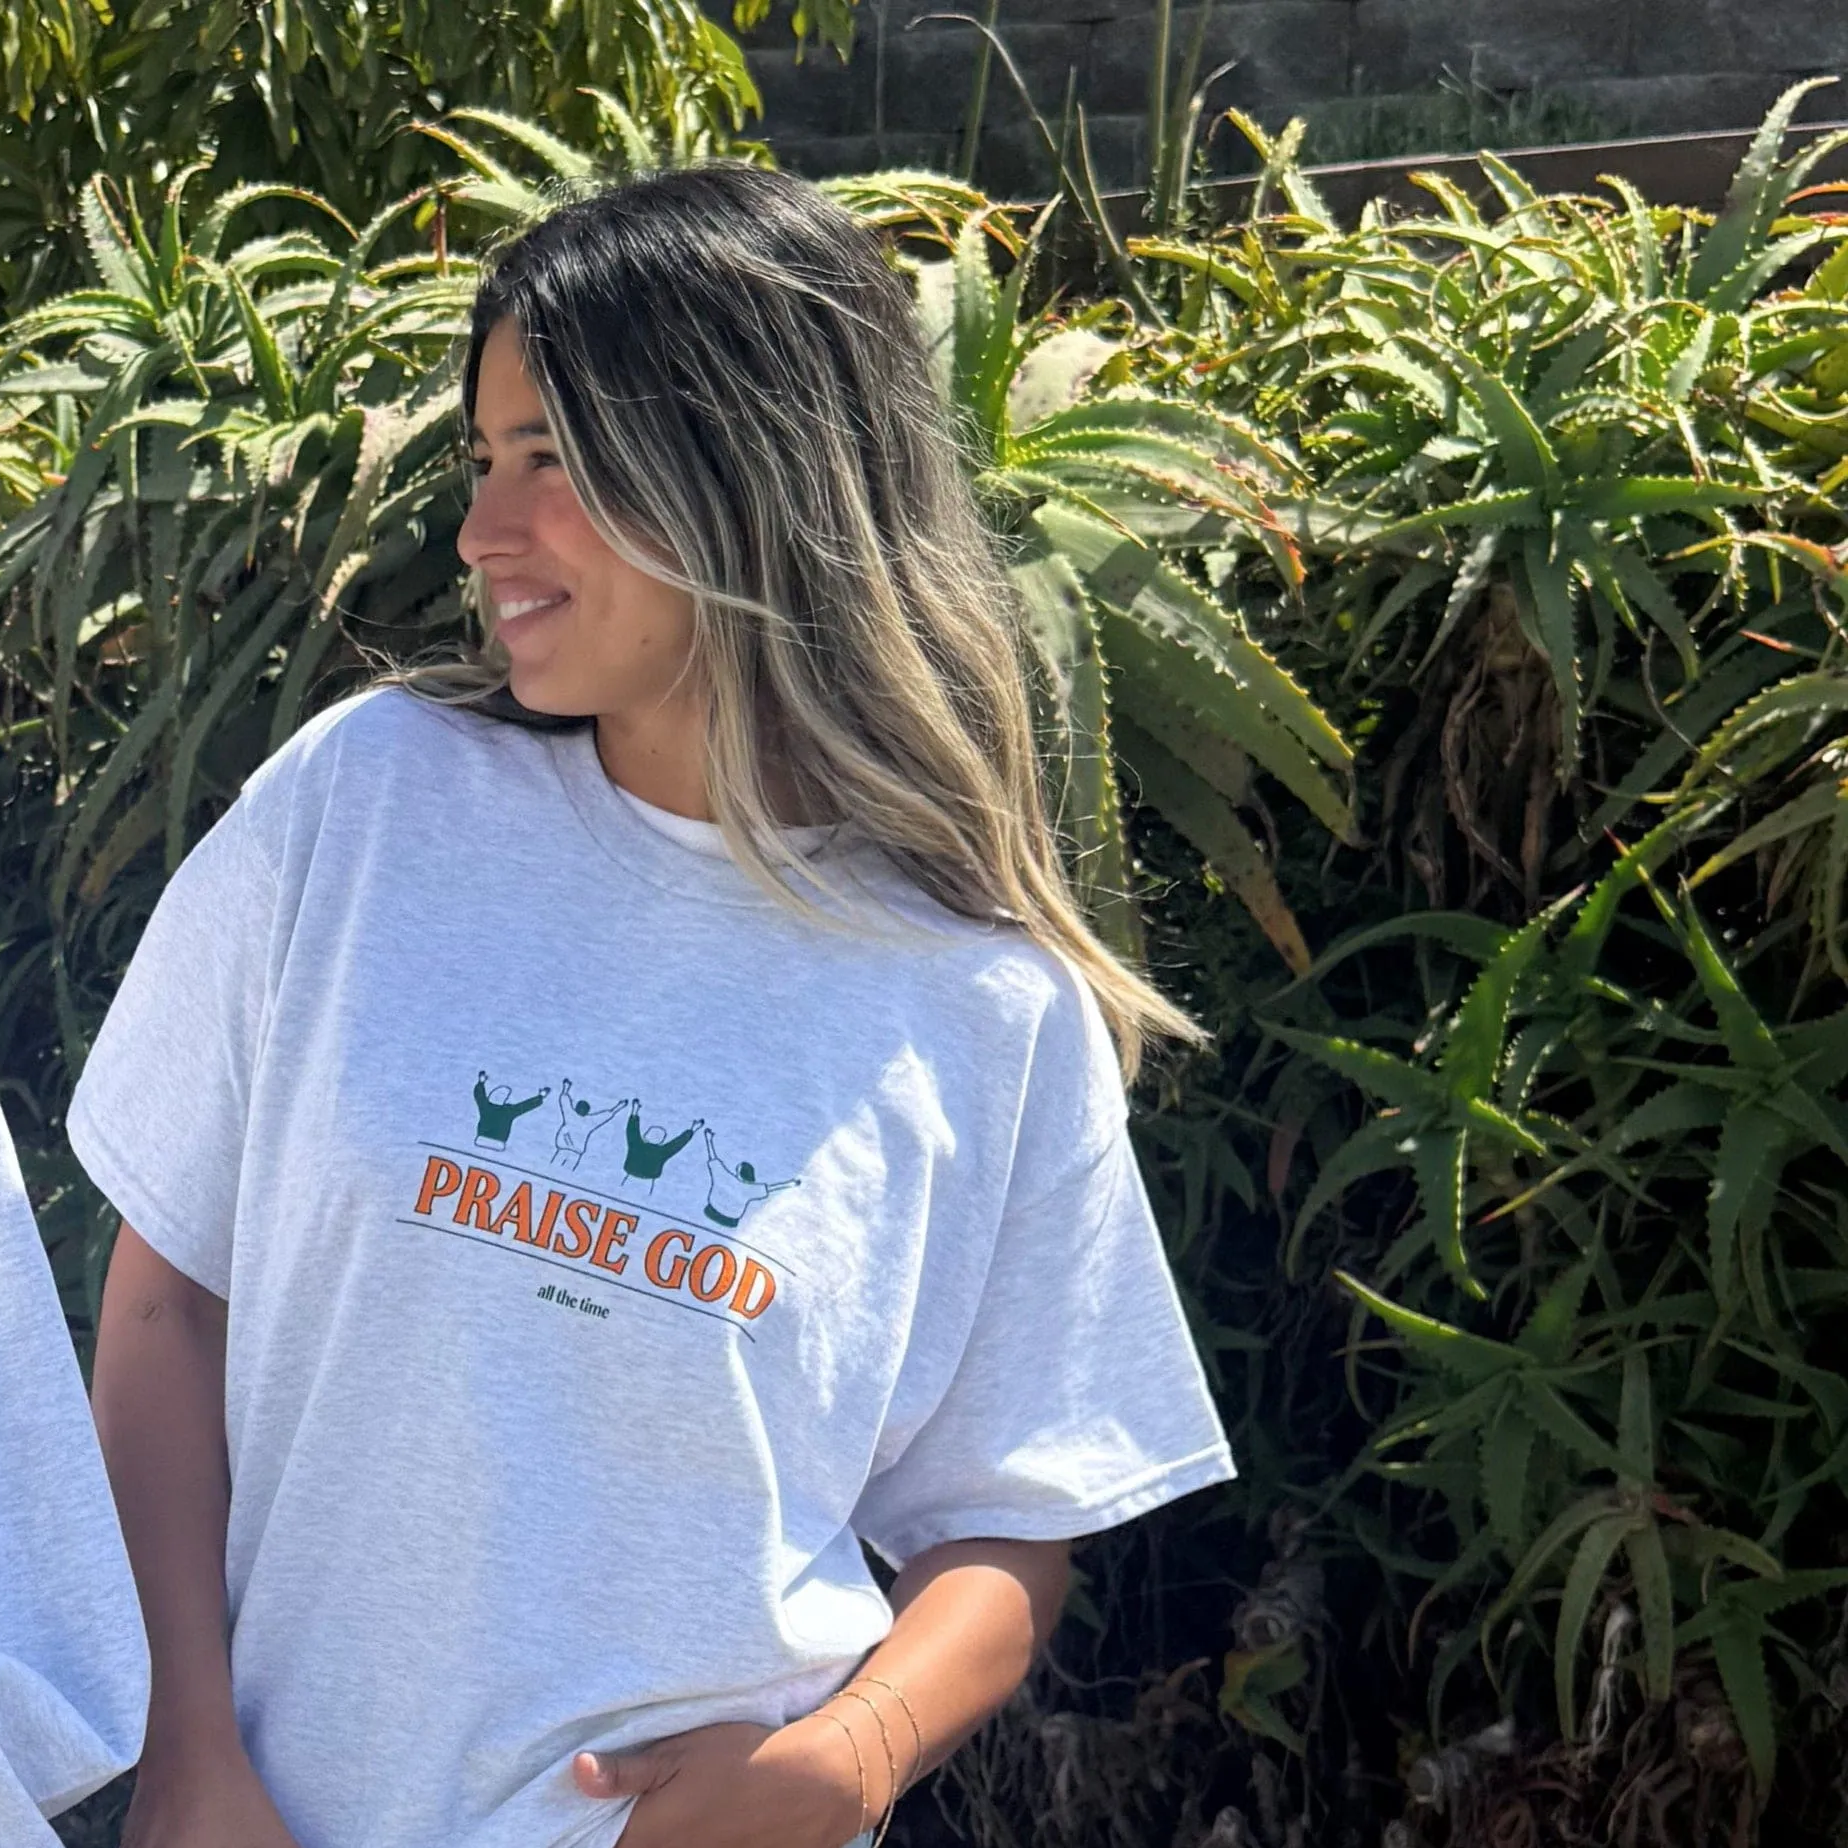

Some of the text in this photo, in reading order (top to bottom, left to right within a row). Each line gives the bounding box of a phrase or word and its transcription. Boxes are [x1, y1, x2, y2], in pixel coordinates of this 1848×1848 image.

[413, 1155, 777, 1320] PRAISE GOD
[536, 1284, 610, 1319] all the time
